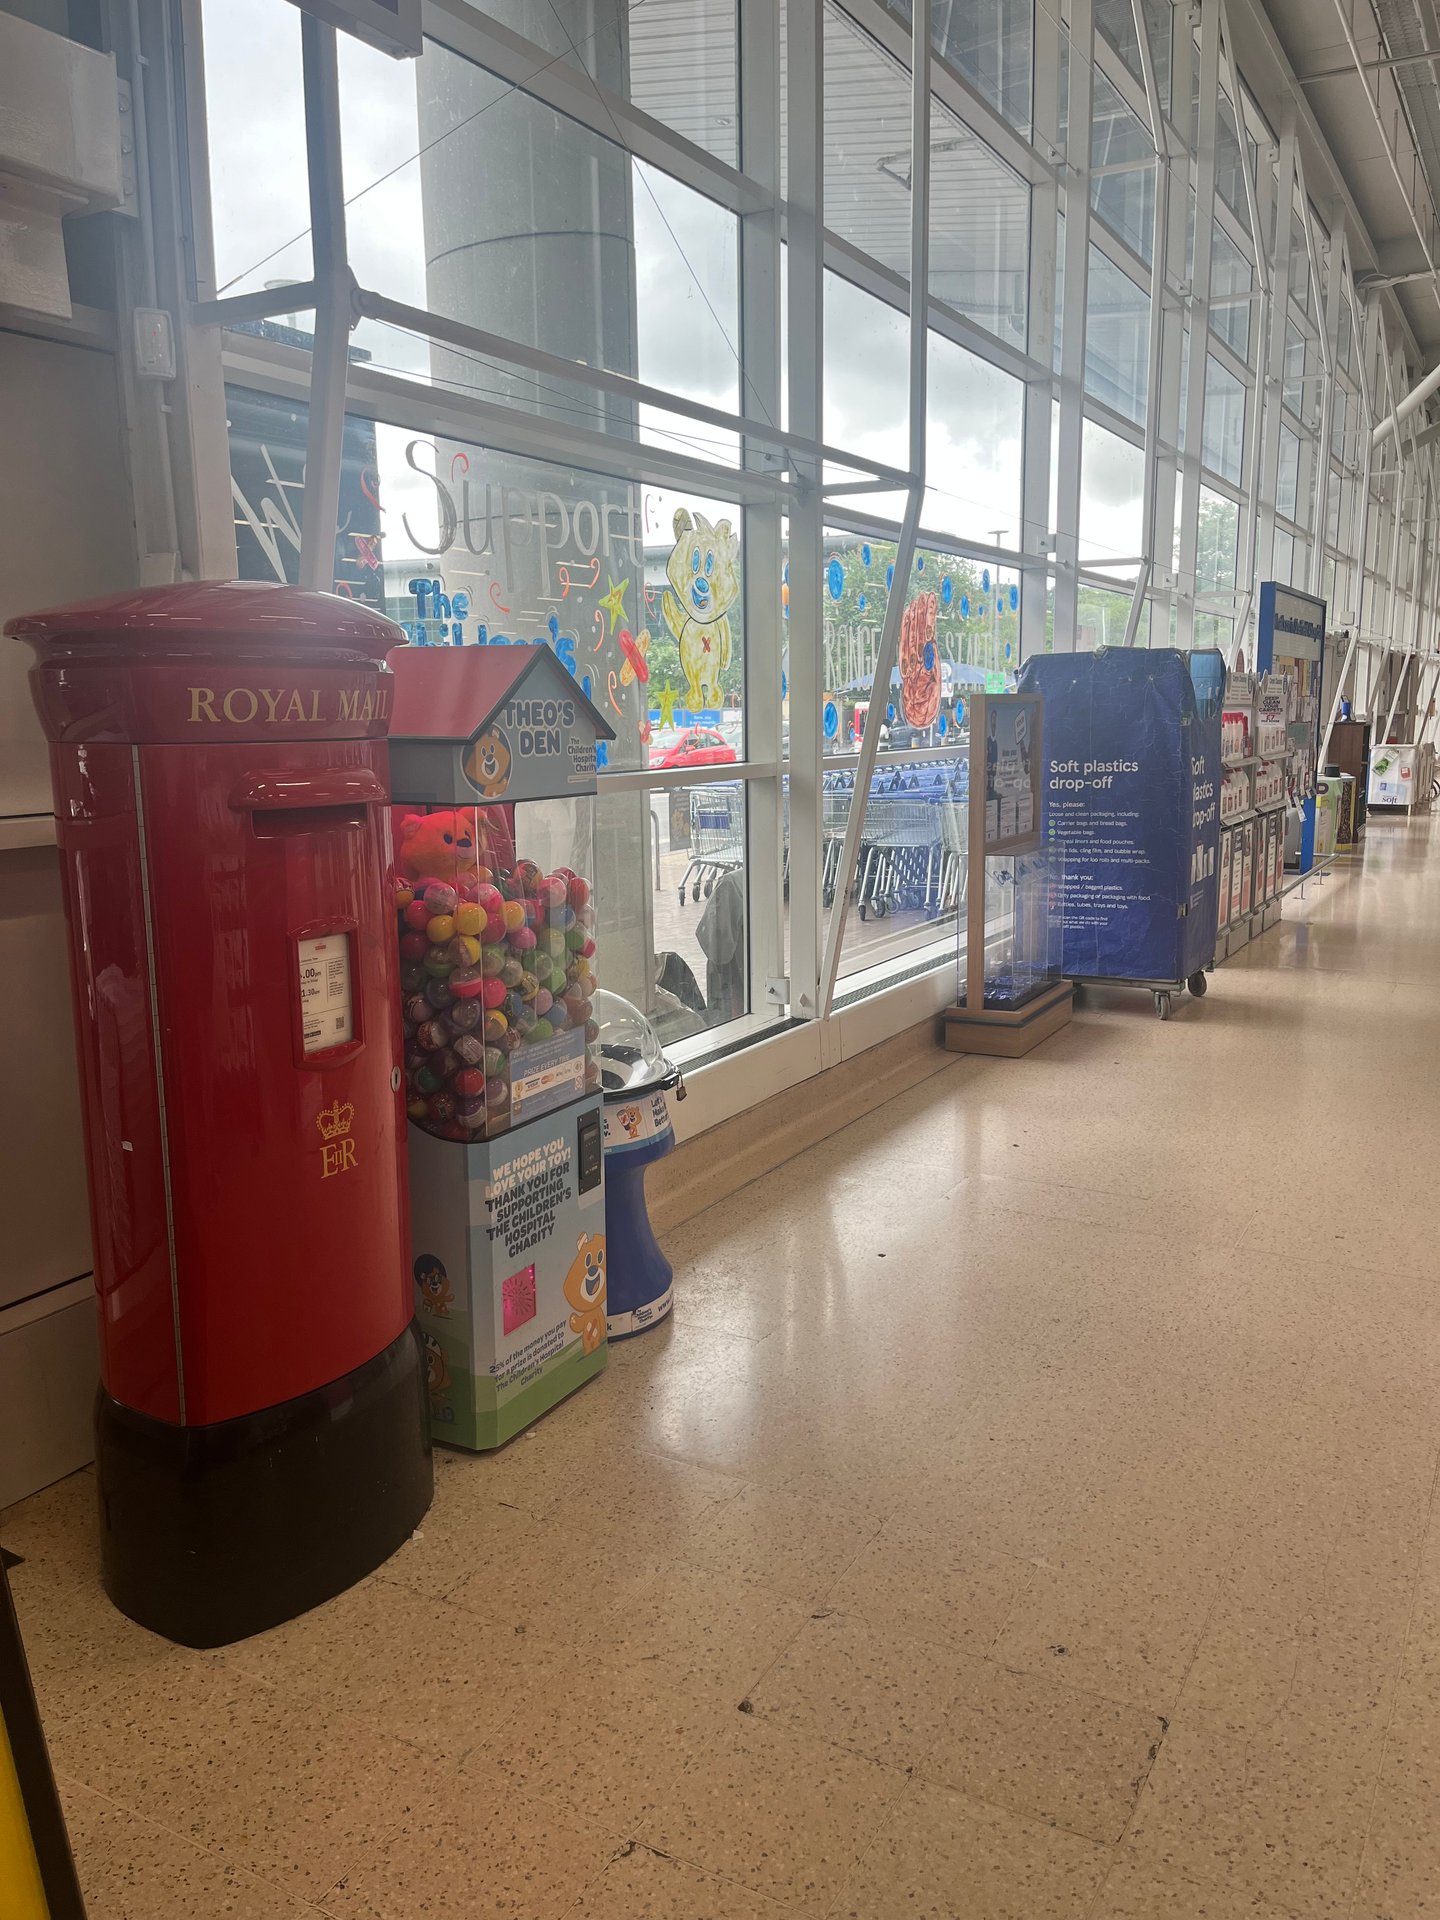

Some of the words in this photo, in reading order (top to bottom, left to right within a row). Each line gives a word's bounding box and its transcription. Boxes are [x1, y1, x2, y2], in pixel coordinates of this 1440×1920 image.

[402, 440, 646, 598] Support
[408, 578, 469, 620] The
[187, 687, 327, 723] ROYAL
[336, 689, 389, 721] MAIL
[504, 700, 575, 729] THEO'S
[520, 728, 561, 756] DEN
[573, 754, 597, 765] Hospita
[1050, 760, 1079, 773] Soft
[1084, 759, 1139, 775] plastics
[1050, 776, 1113, 792] drop-off
[1062, 801, 1086, 809] please:
[1192, 780, 1214, 801] lastics
[1192, 802, 1216, 829] rop-off
[485, 1176, 516, 1199] LOVE
[518, 1160, 547, 1182] YOUR
[548, 1147, 571, 1167] TOY!
[493, 1162, 511, 1181] WE
[512, 1147, 542, 1170] HOPE
[543, 1137, 564, 1155] YOU
[485, 1184, 525, 1212] THANK
[527, 1172, 549, 1192] YOU
[550, 1162, 570, 1181] FOR
[497, 1178, 564, 1222] SUPPORTING
[486, 1219, 510, 1240] THE
[512, 1187, 571, 1228] CHILDREN'S
[505, 1210, 556, 1246] HOSPITAL
[509, 1222, 555, 1258] CHARITY
[489, 1360, 505, 1374] 25%
[505, 1353, 512, 1365] of
[513, 1348, 523, 1360] the
[524, 1336, 544, 1353] money
[544, 1328, 555, 1341] you
[556, 1320, 567, 1333] pay
[495, 1370, 505, 1383] for
[510, 1358, 527, 1374] prize
[527, 1352, 533, 1360] is
[533, 1337, 557, 1357] donated
[558, 1331, 565, 1341] to
[496, 1380, 508, 1393] The
[509, 1359, 540, 1384] Children's
[540, 1340, 564, 1362] Hospital
[520, 1366, 543, 1386] Charity
